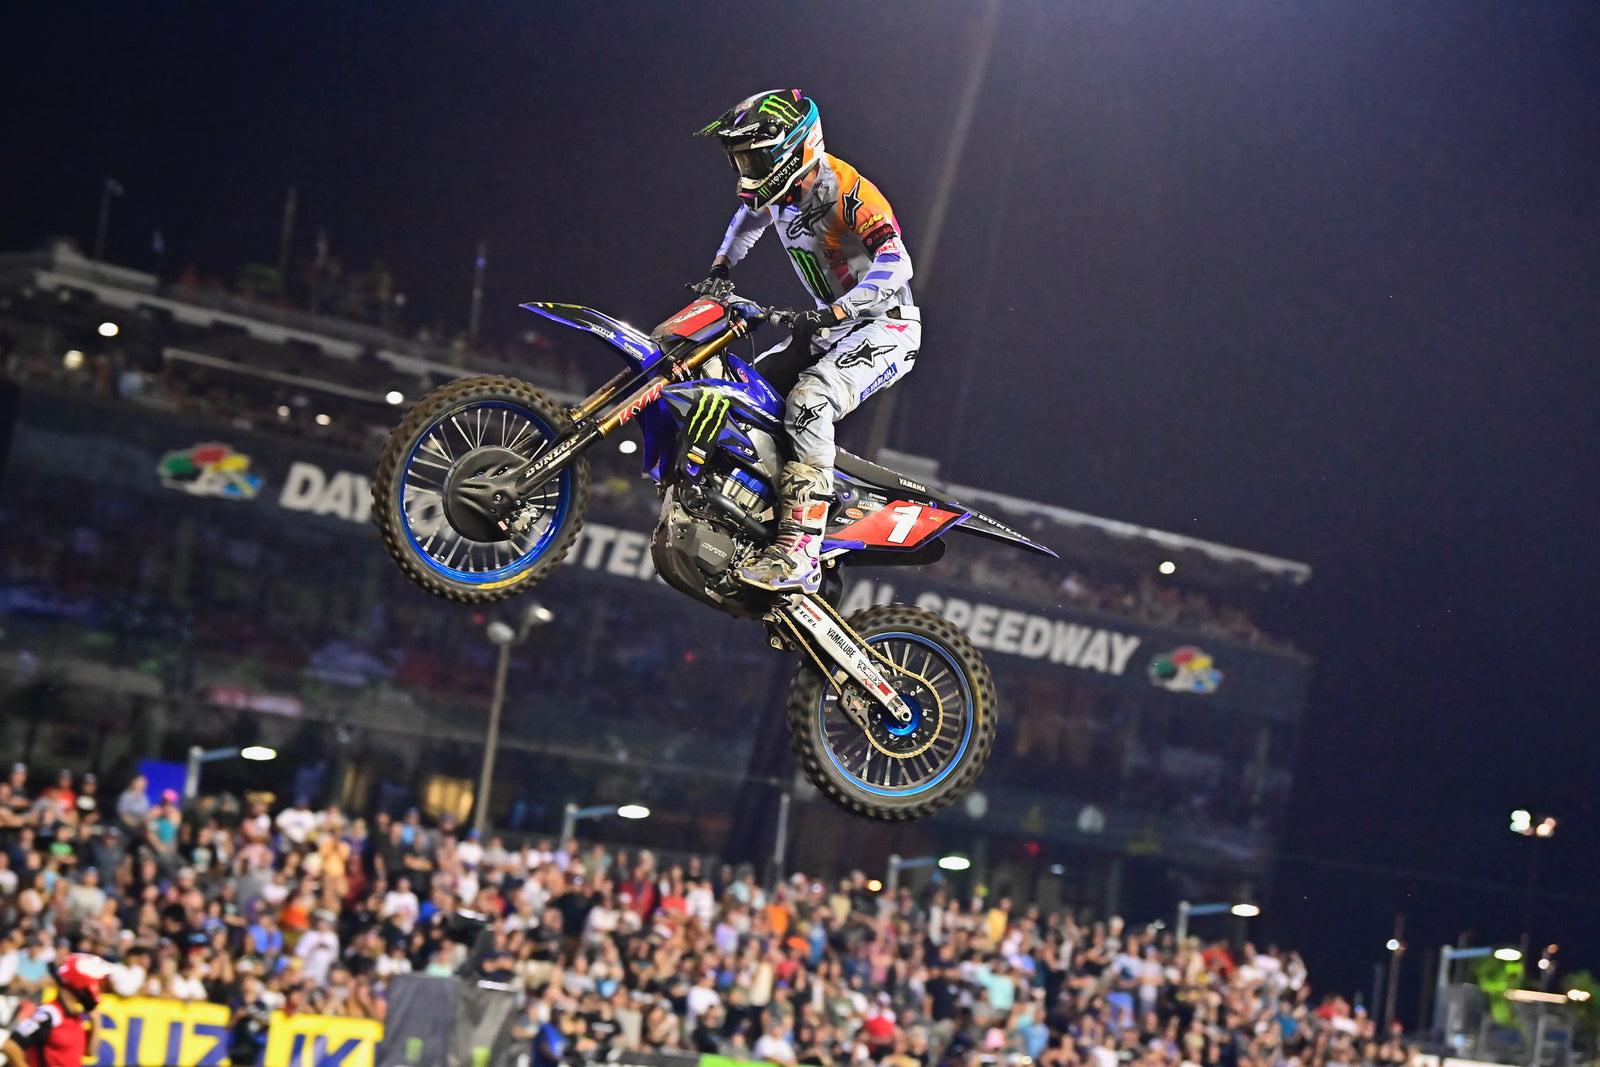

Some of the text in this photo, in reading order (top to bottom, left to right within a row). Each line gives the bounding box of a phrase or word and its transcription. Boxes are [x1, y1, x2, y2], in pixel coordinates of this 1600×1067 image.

[768, 156, 800, 188] MONSTER
[525, 434, 581, 478] DUNLOP
[899, 478, 927, 493] YAMAHA
[886, 505, 923, 544] 1
[978, 514, 1032, 542] DUNLOP
[794, 606, 816, 628] EXCEL
[826, 627, 857, 659] YAMALUBE
